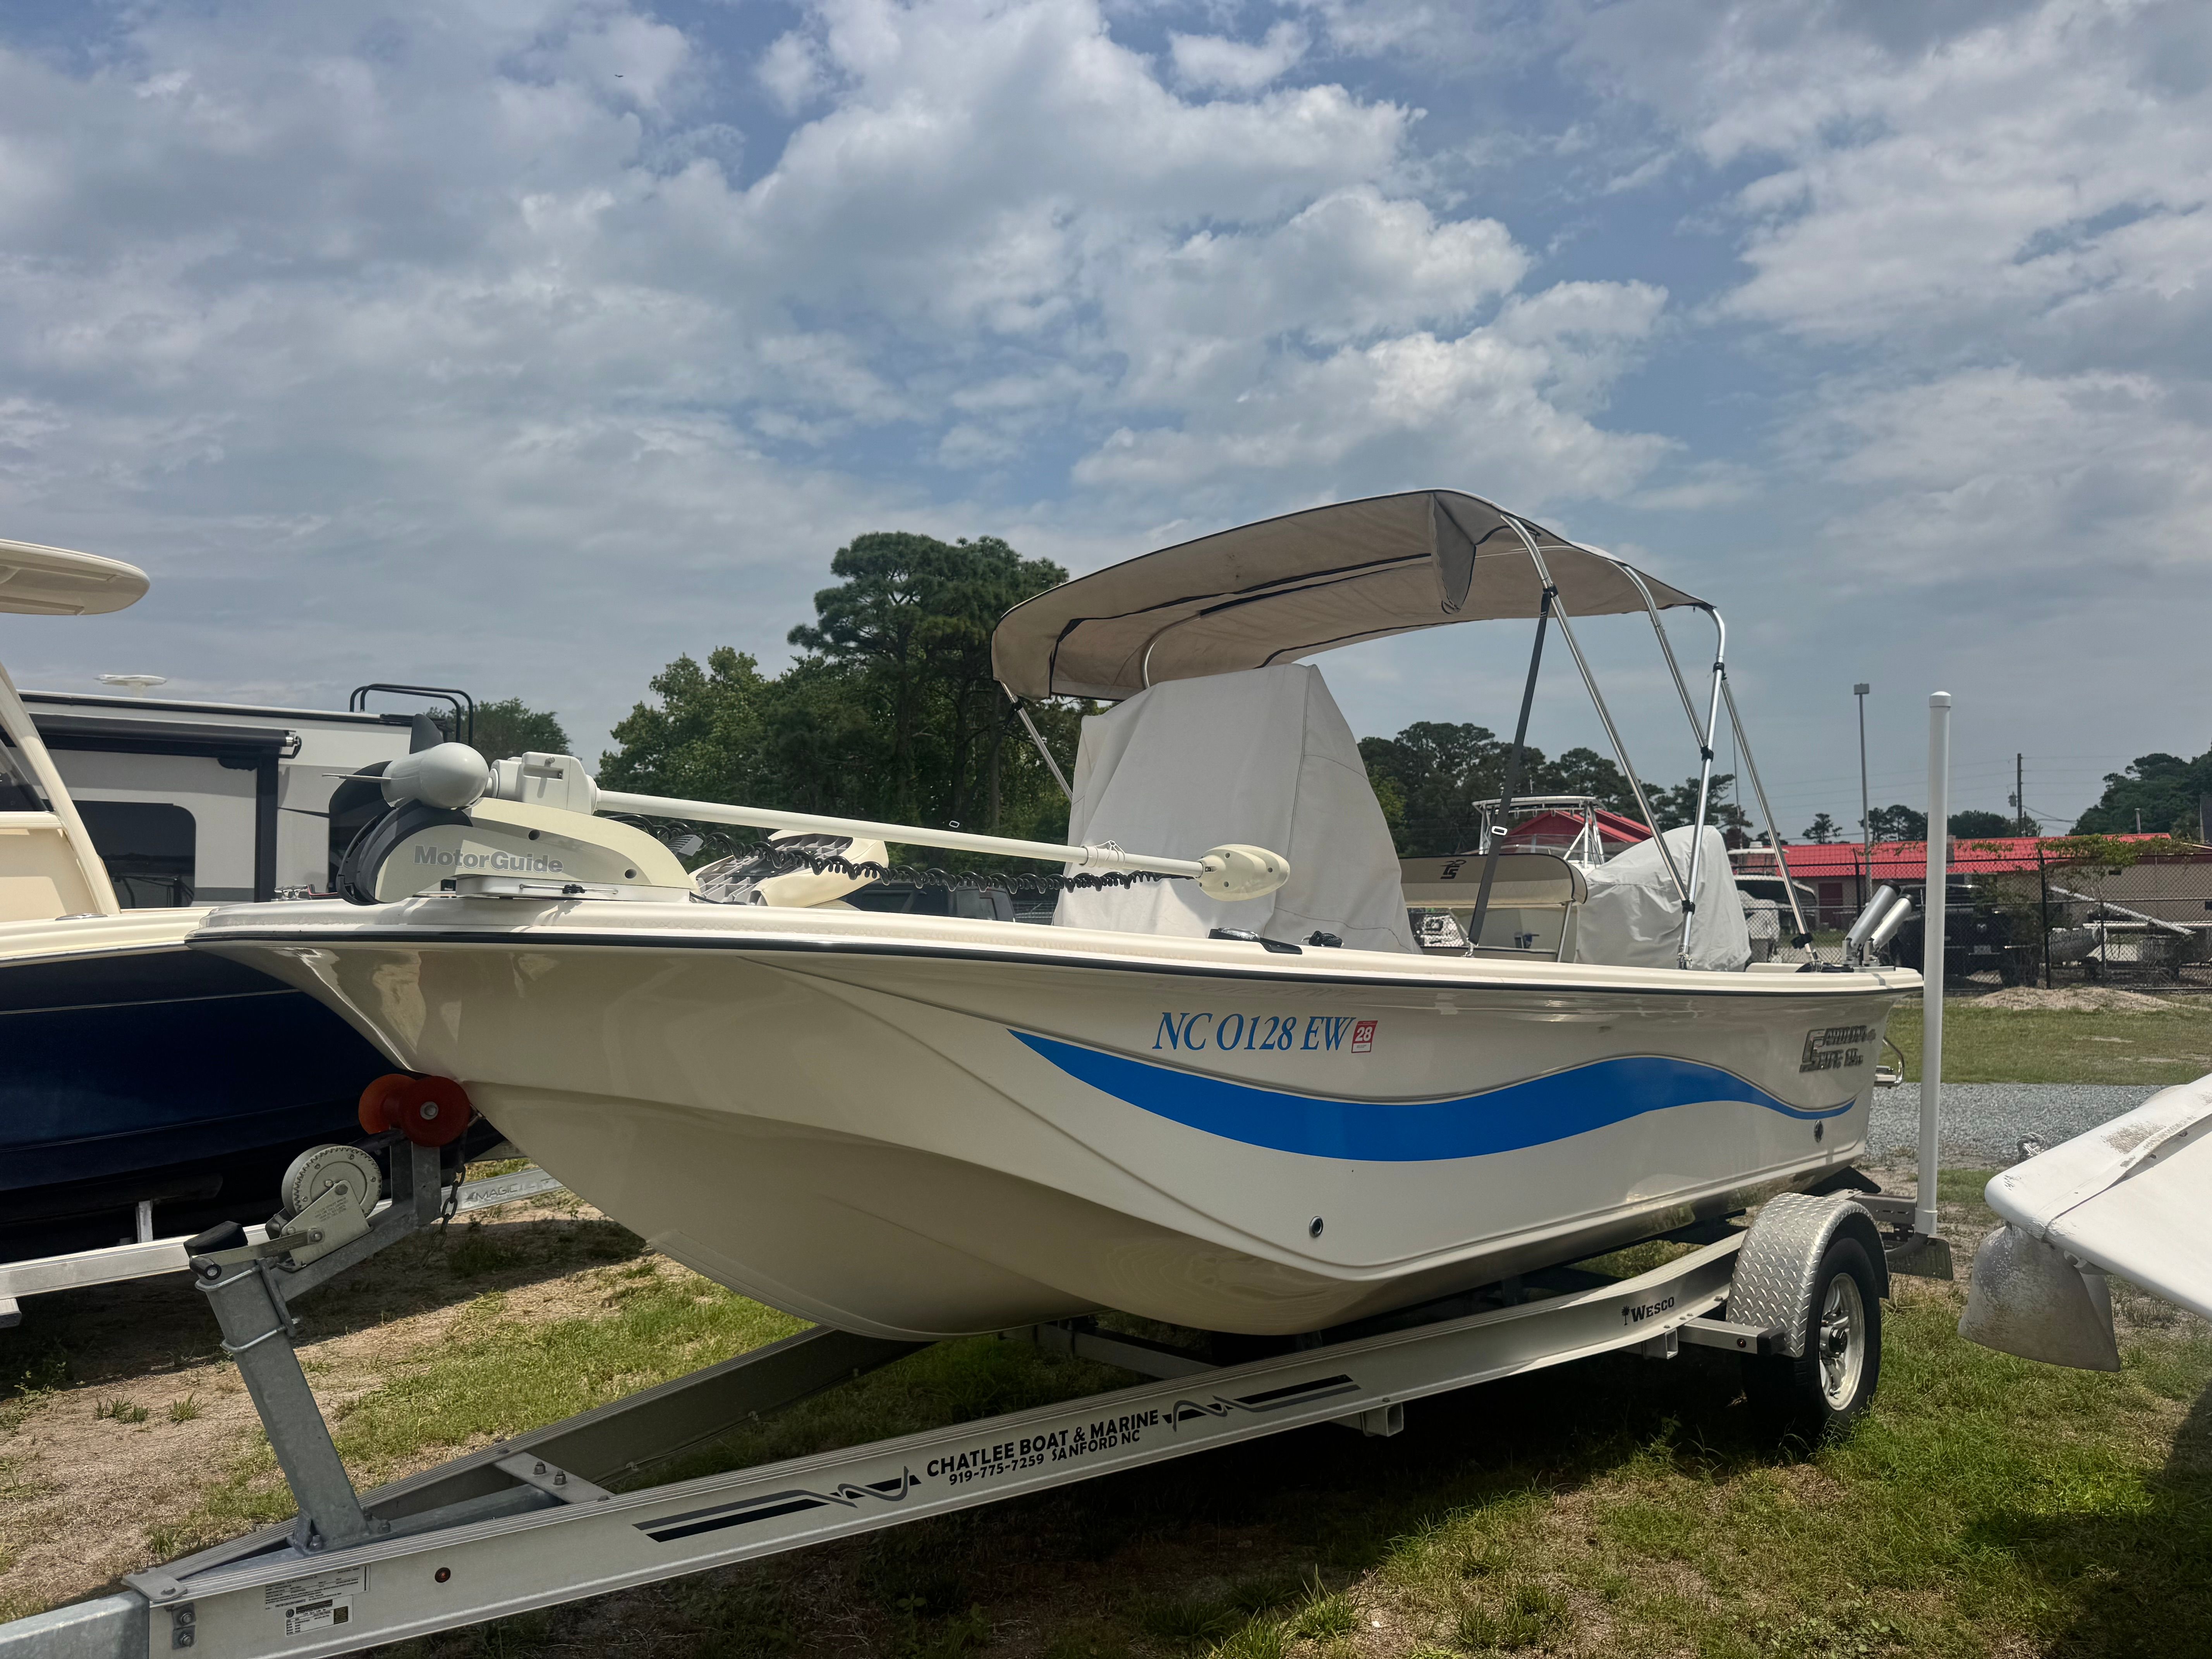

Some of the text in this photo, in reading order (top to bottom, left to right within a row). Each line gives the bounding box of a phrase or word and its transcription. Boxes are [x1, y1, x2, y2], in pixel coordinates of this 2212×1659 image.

[414, 845, 563, 874] MotorGuide
[1152, 1012, 1212, 1050] NC
[1300, 1016, 1357, 1051] EW
[1355, 1026, 1373, 1041] 28
[476, 1183, 518, 1201] MAGIC
[927, 1409, 1159, 1477] CHATLEE BOAT & MARINE
[1051, 1429, 1140, 1462] SANFORD NC
[949, 1453, 1044, 1486] 919-775-7259
